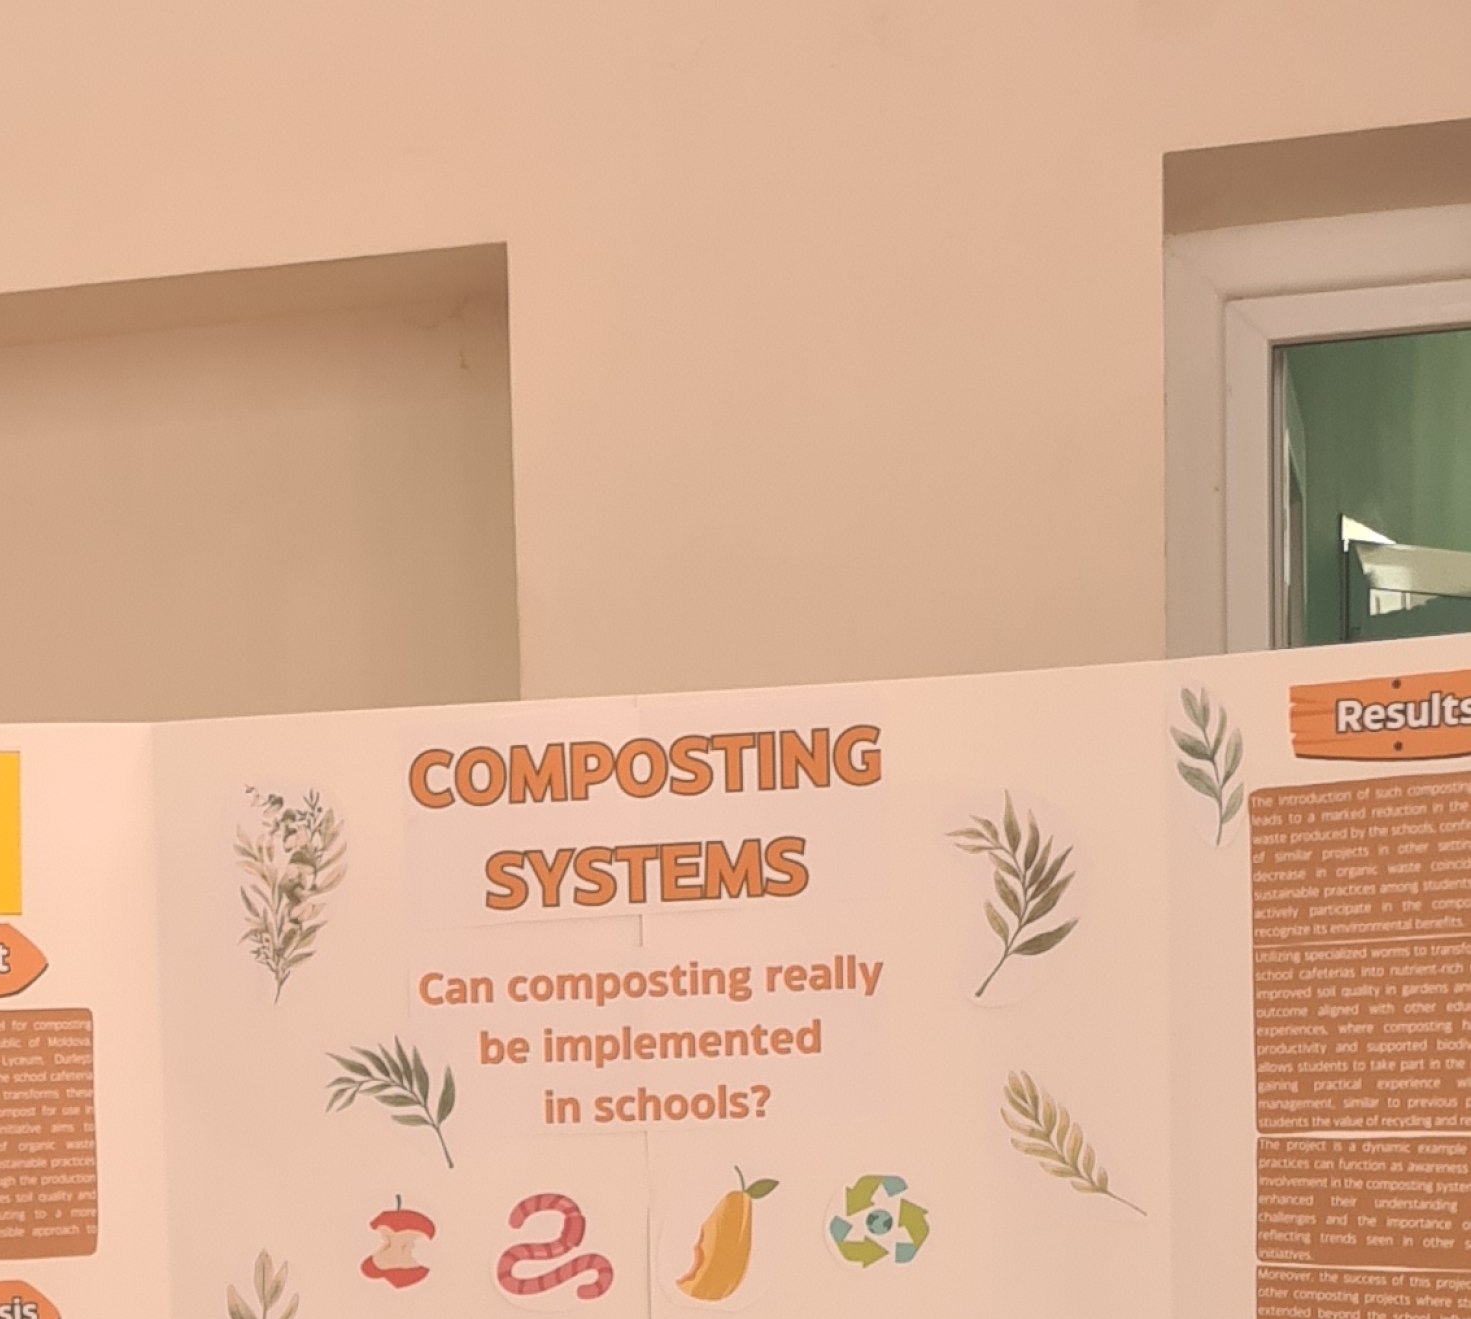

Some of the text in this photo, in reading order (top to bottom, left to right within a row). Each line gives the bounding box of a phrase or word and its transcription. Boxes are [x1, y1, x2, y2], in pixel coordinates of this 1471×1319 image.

[1336, 691, 1471, 734] Results
[409, 724, 882, 809] COMPOSTING
[485, 835, 809, 911] SYSTEMS
[418, 955, 884, 1008] Can composting really
[479, 1019, 822, 1068] be implemented
[544, 1084, 772, 1124] in schools?
